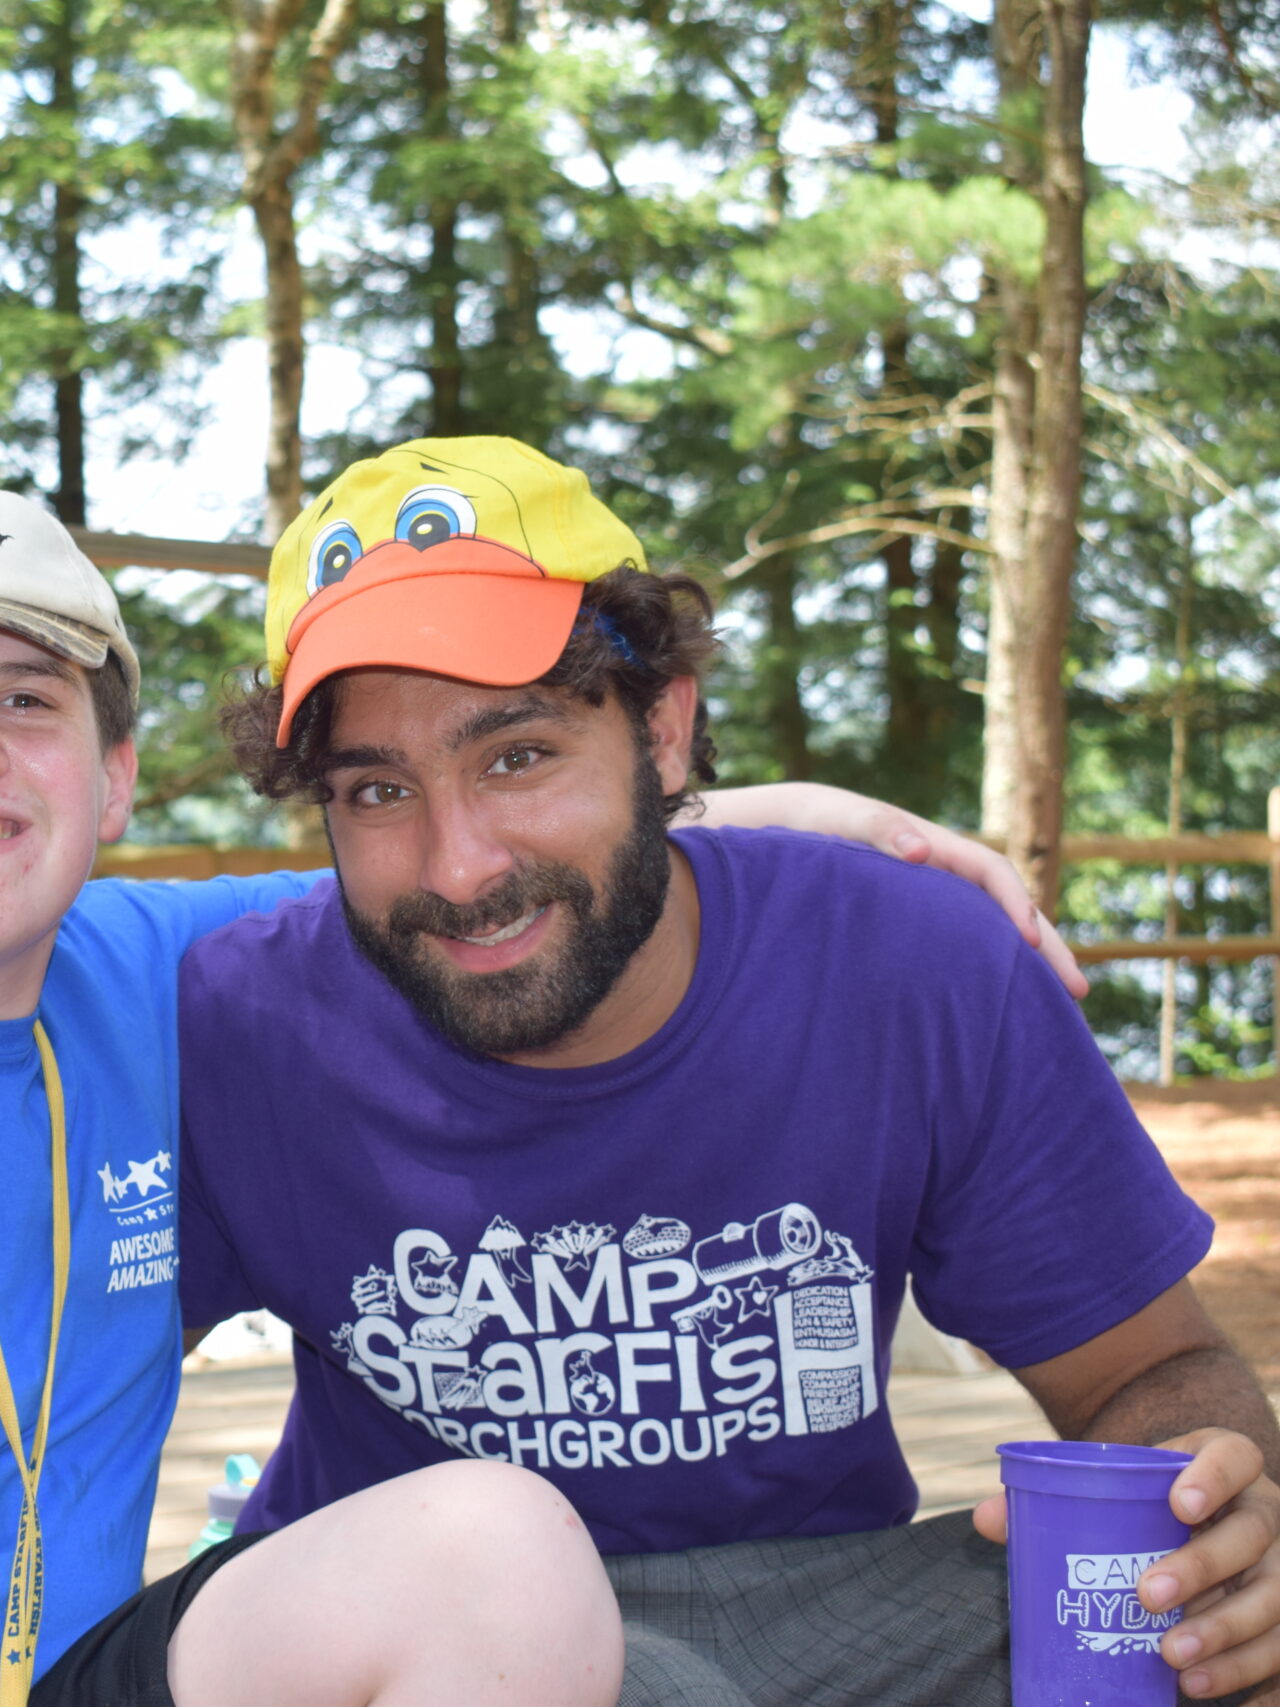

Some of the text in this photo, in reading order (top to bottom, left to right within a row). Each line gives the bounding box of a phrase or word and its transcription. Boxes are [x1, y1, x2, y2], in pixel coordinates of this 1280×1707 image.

[109, 1226, 175, 1266] AWESOME
[106, 1255, 174, 1294] AMAZING
[393, 1229, 698, 1335] CAMP
[793, 1286, 848, 1299] DEDICATION
[793, 1296, 850, 1309] ACCEPTANCE
[794, 1306, 853, 1318] LEADERSHIP
[794, 1317, 812, 1328] FUN
[821, 1316, 854, 1327] SAFETY
[794, 1326, 857, 1339] ENTHUSIASM
[800, 1366, 860, 1380] COMPASSION
[802, 1376, 858, 1389] COMMUNITY
[382, 1396, 781, 1468] ORCHGROUPS
[8, 1493, 29, 1638] CAMP STARFI
[1073, 1555, 1167, 1586] CAM
[29, 1537, 43, 1636] STARFISH
